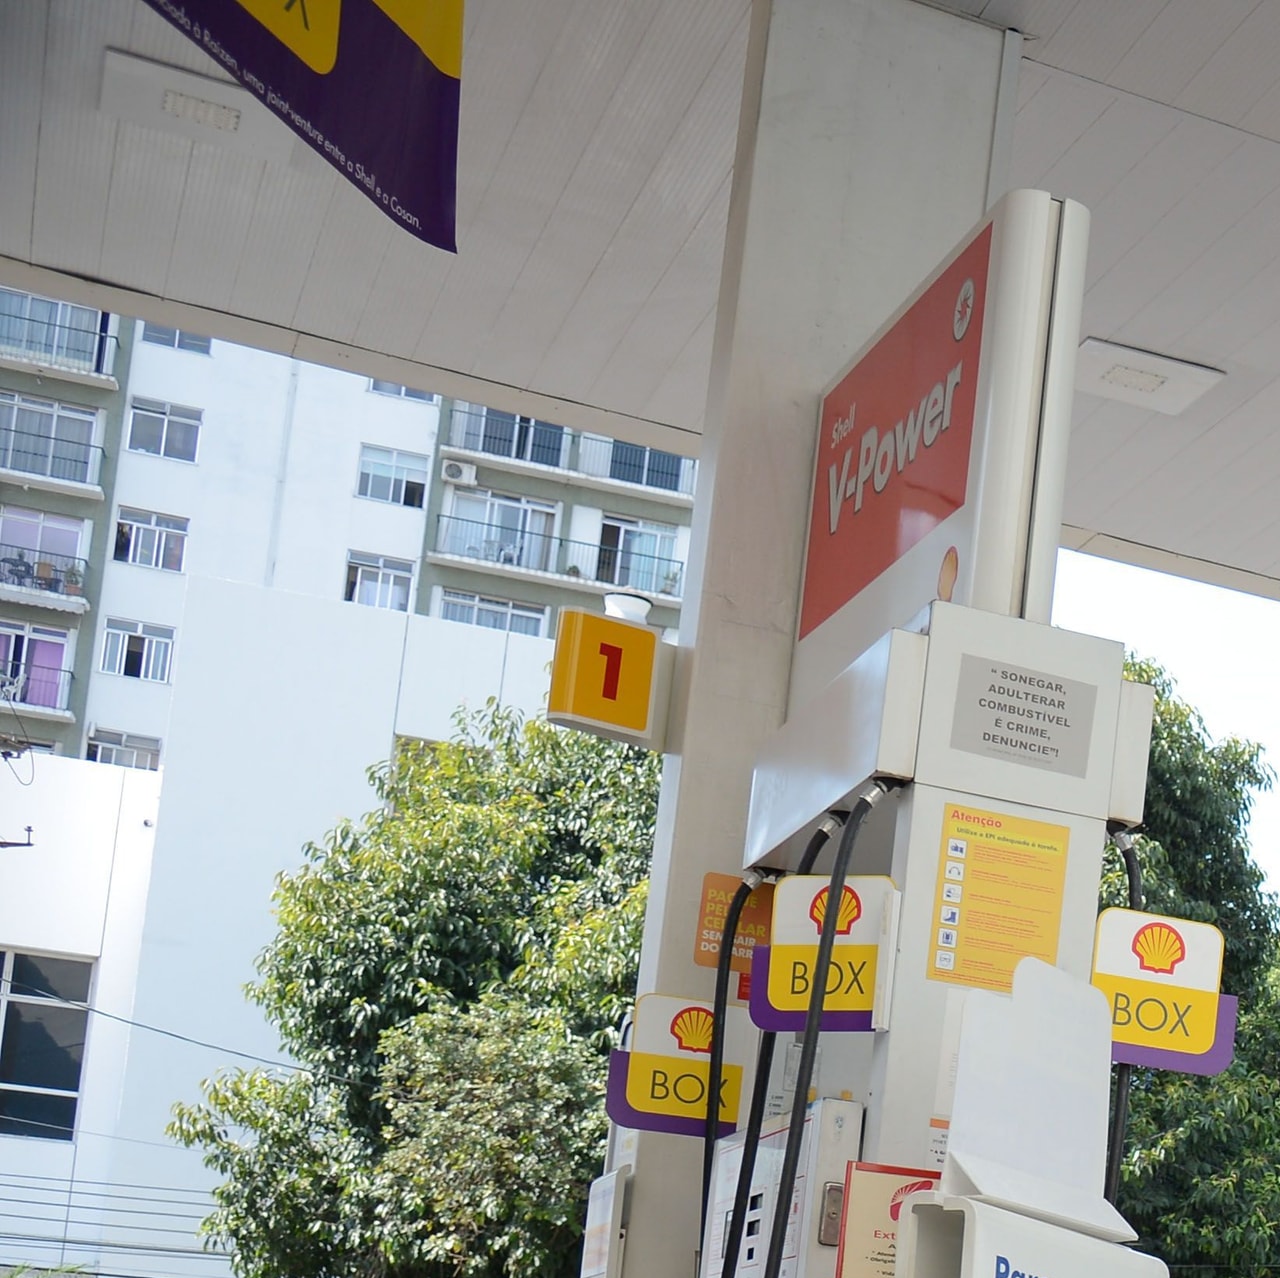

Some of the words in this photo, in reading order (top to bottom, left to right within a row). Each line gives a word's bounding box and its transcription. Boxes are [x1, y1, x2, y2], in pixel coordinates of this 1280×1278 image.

[243, 68, 265, 94] uma
[267, 86, 325, 145] joint-venture
[324, 138, 346, 165] entre
[355, 164, 375, 190] Shell
[390, 197, 422, 230] Cosan.
[831, 403, 856, 448] Shell
[828, 359, 963, 535] V-Power
[599, 642, 623, 701] 1
[1001, 670, 1067, 695] SONEGAR,
[979, 698, 1071, 728] COMBUSTÍVEL
[988, 684, 1066, 710] ADULTERAR
[994, 716, 1003, 728] É
[1007, 721, 1051, 740] CRIME,
[951, 810, 1002, 828] Atenção
[701, 942, 719, 953] DO
[790, 961, 868, 996] BOX
[1112, 992, 1192, 1037] BOX
[650, 1069, 729, 1109] BOX
